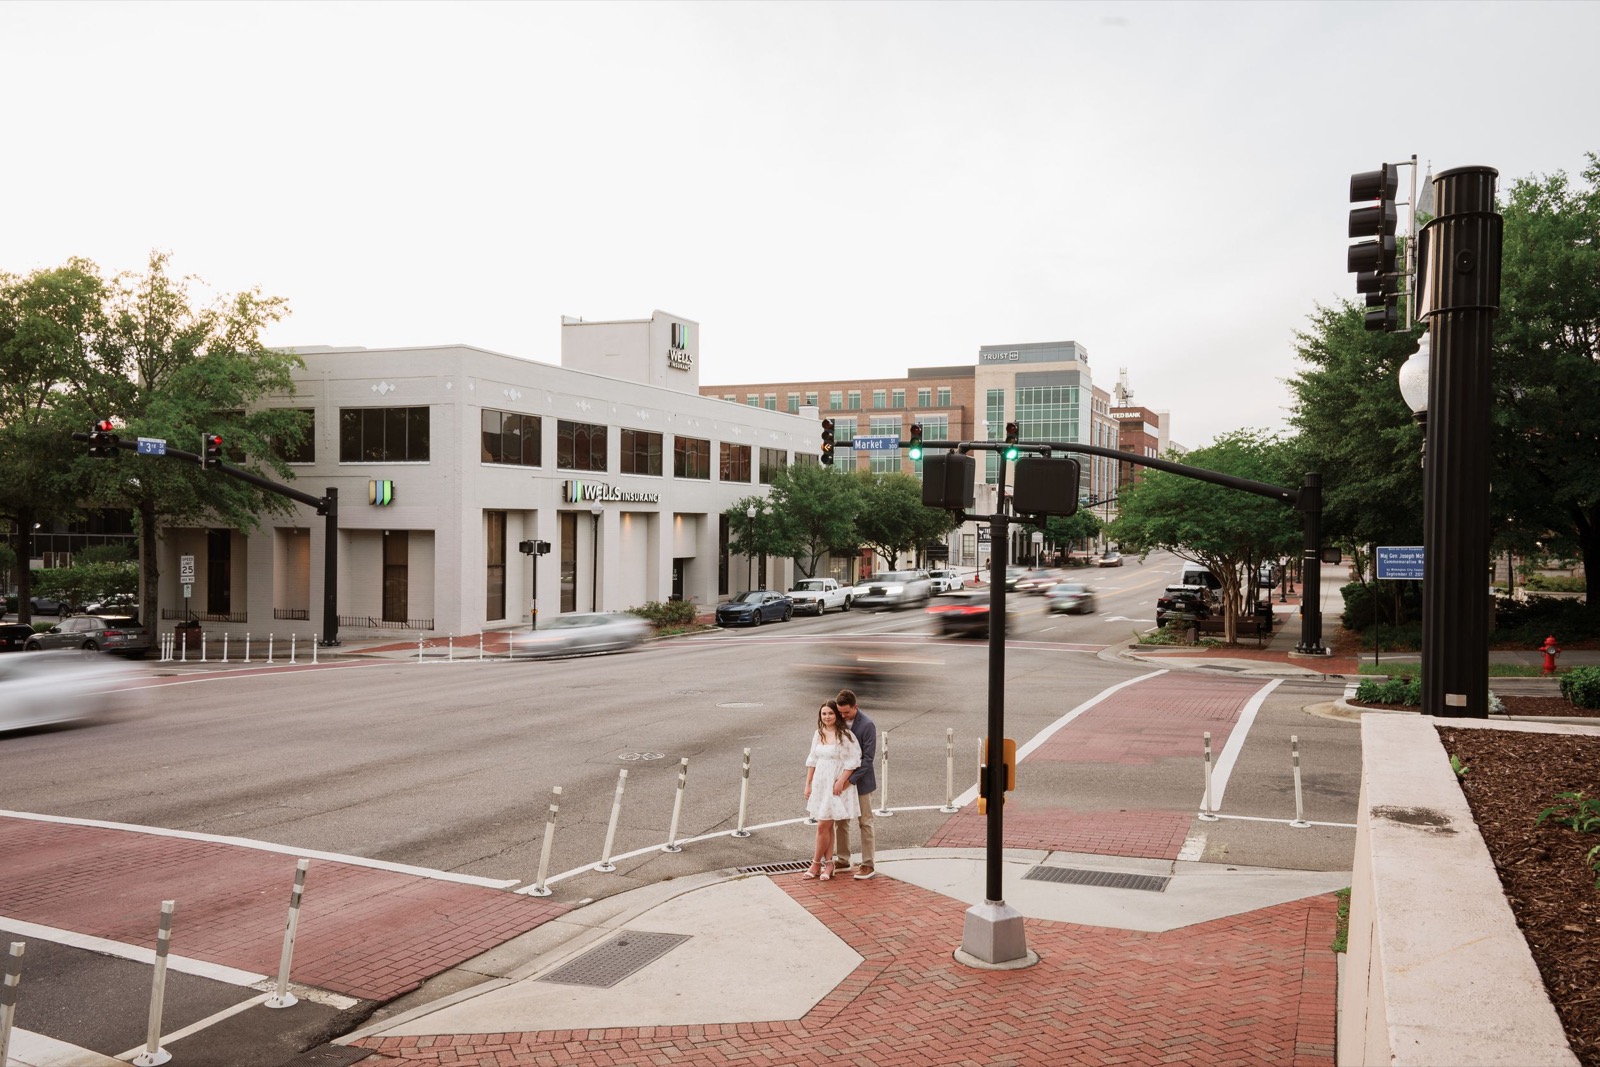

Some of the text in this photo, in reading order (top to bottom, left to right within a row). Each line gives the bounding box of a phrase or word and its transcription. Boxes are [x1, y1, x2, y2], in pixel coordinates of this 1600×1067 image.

[669, 350, 693, 365] WELLS
[855, 439, 883, 449] Market
[583, 485, 661, 503] WELLS INSURANCE
[182, 565, 194, 574] 25
